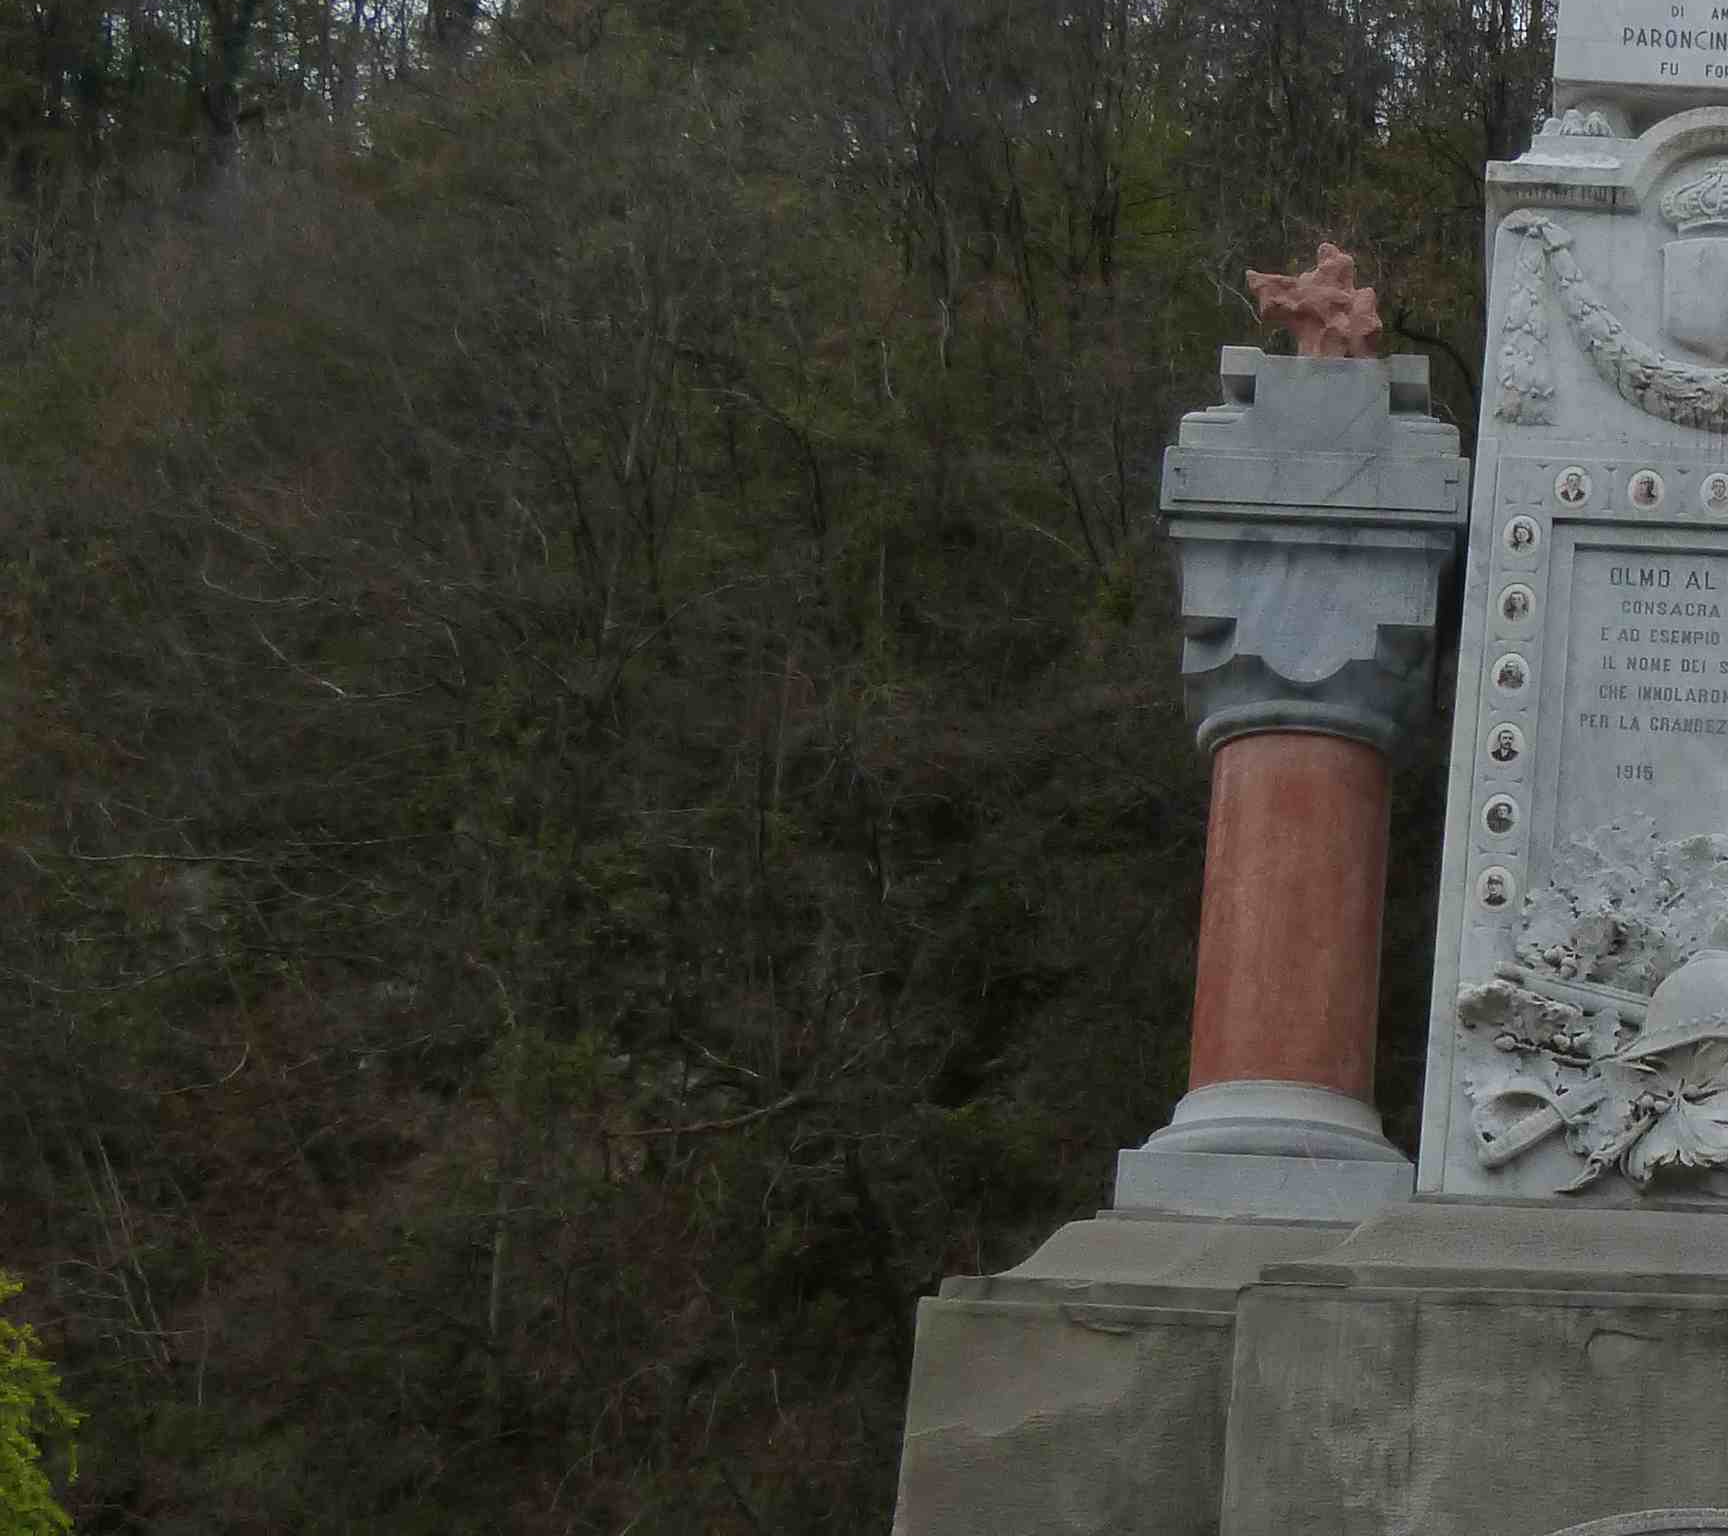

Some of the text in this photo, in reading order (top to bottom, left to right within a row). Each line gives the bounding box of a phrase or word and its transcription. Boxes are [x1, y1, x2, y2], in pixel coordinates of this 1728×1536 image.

[1672, 5, 1684, 18] DI
[1660, 62, 1679, 76] FU
[1610, 567, 1670, 588] OLMO
[1685, 571, 1716, 590] AL
[1622, 600, 1720, 618] CONSACRA
[1617, 628, 1640, 642] AD
[1650, 629, 1720, 646] ESEMPIO
[1602, 656, 1617, 670] IL
[1626, 657, 1672, 671] NOME
[1681, 658, 1706, 674] DEI
[1599, 684, 1627, 700] CHE
[1580, 714, 1609, 729] PER
[1619, 715, 1640, 731] LA
